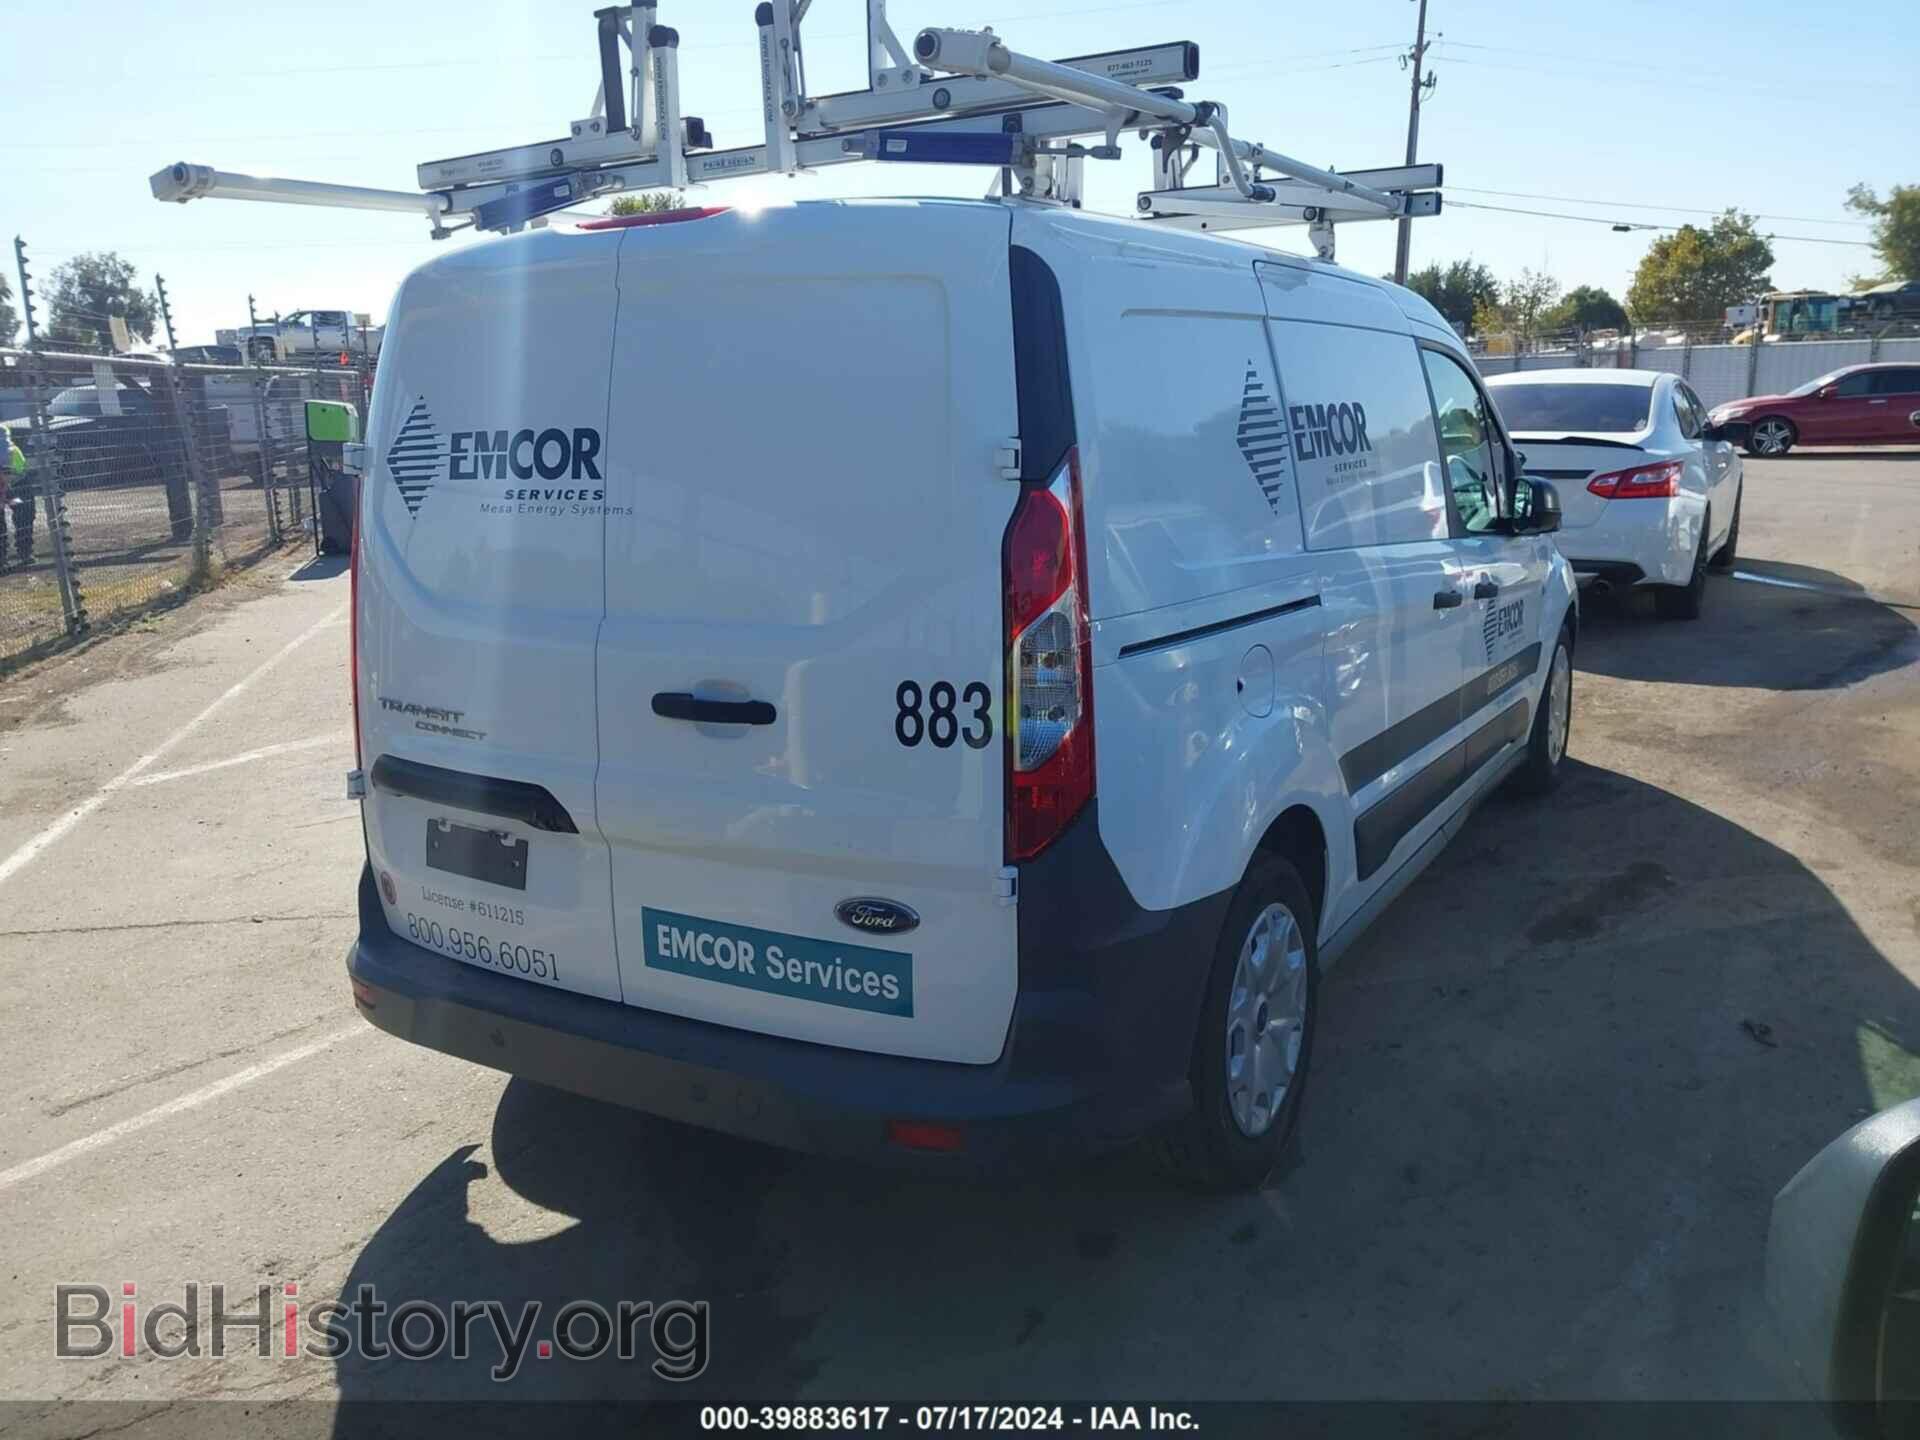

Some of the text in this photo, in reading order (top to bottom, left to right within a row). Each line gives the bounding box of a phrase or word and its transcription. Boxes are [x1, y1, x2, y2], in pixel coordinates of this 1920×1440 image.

[449, 428, 602, 480] EMCOR
[1289, 401, 1372, 461] EMCOR
[480, 503, 633, 517] Mesa Energy Systems
[504, 489, 604, 501] SERVICES
[378, 697, 465, 723] TRANSIT
[895, 680, 993, 749] 883
[421, 886, 465, 911] License
[469, 901, 525, 926] #611215
[852, 904, 897, 928] Ford
[407, 912, 561, 981] 800.956.6051
[656, 923, 900, 1000] EMCOR Services
